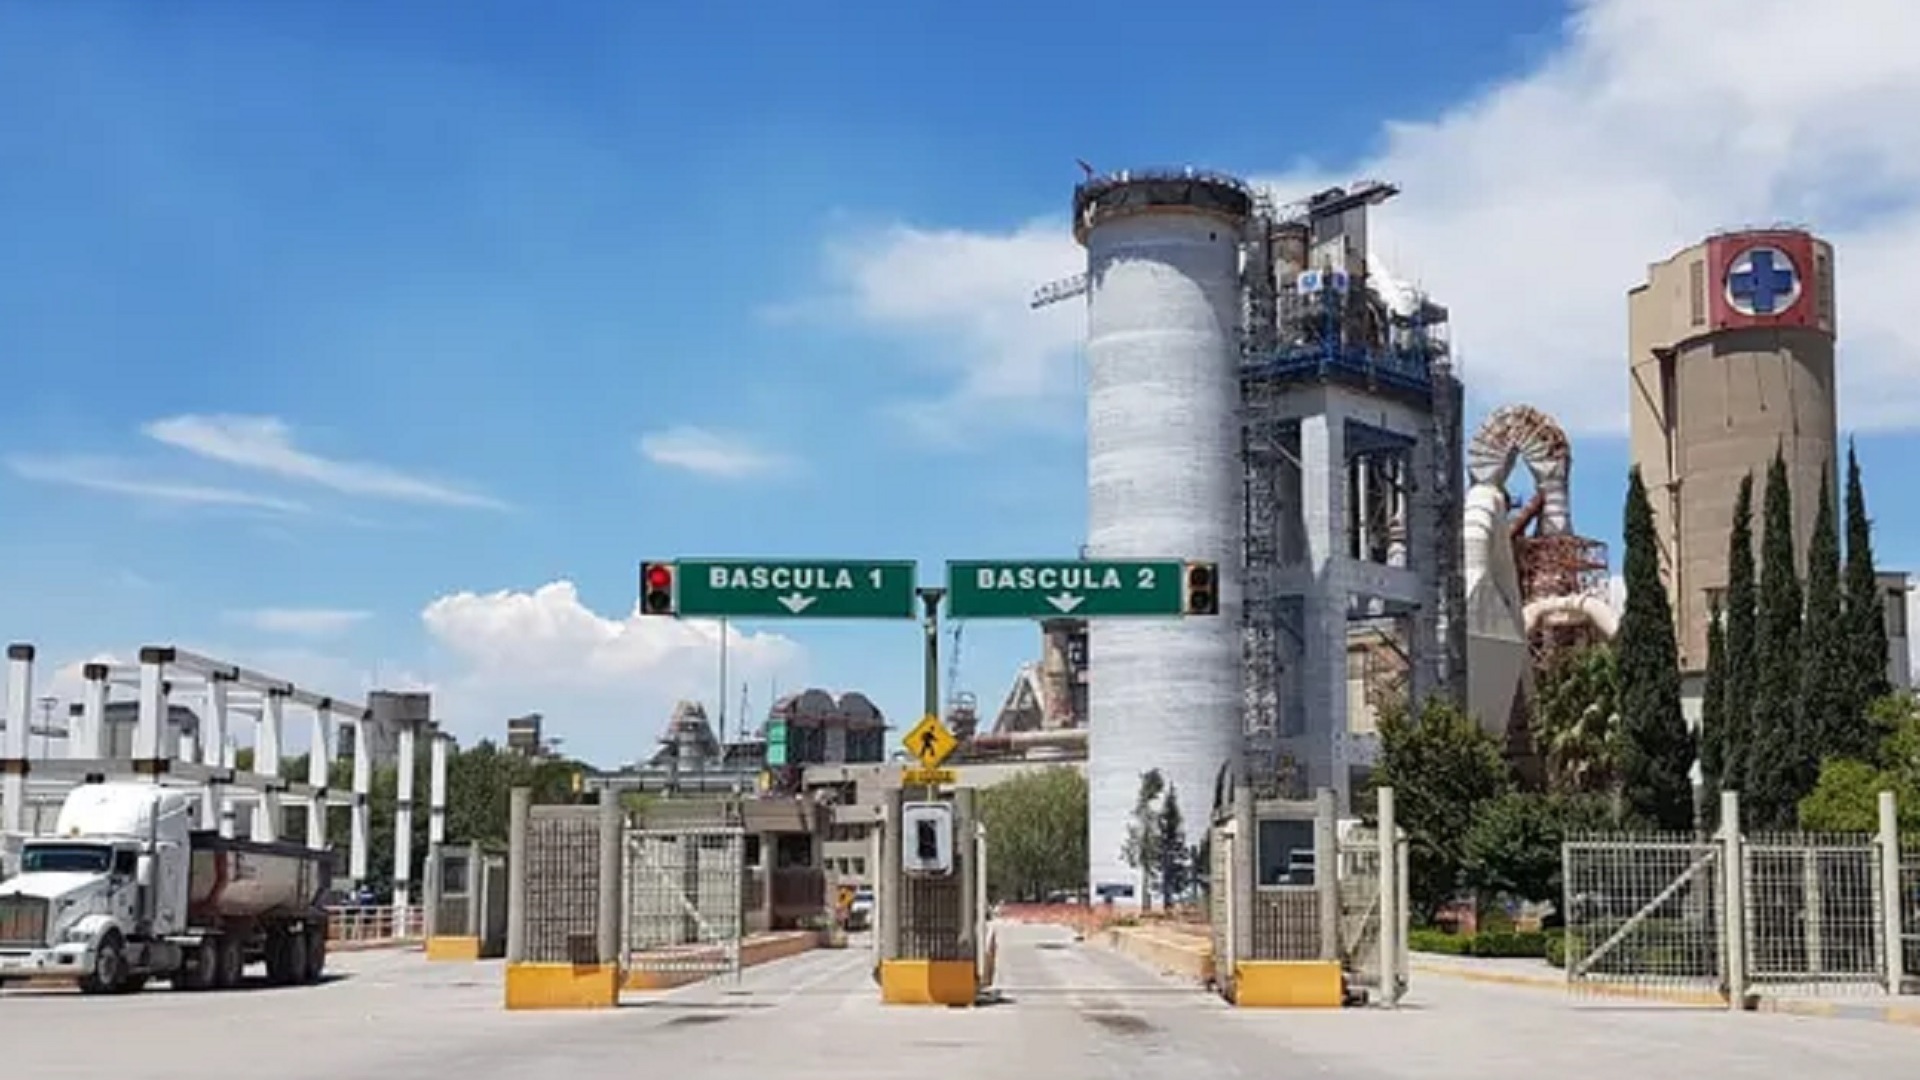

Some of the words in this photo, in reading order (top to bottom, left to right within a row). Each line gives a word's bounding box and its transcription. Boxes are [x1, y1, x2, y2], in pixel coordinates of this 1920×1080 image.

[710, 567, 853, 588] BASCULA
[869, 568, 882, 588] 1
[978, 568, 1121, 588] BASCULA
[1138, 568, 1155, 588] 2
